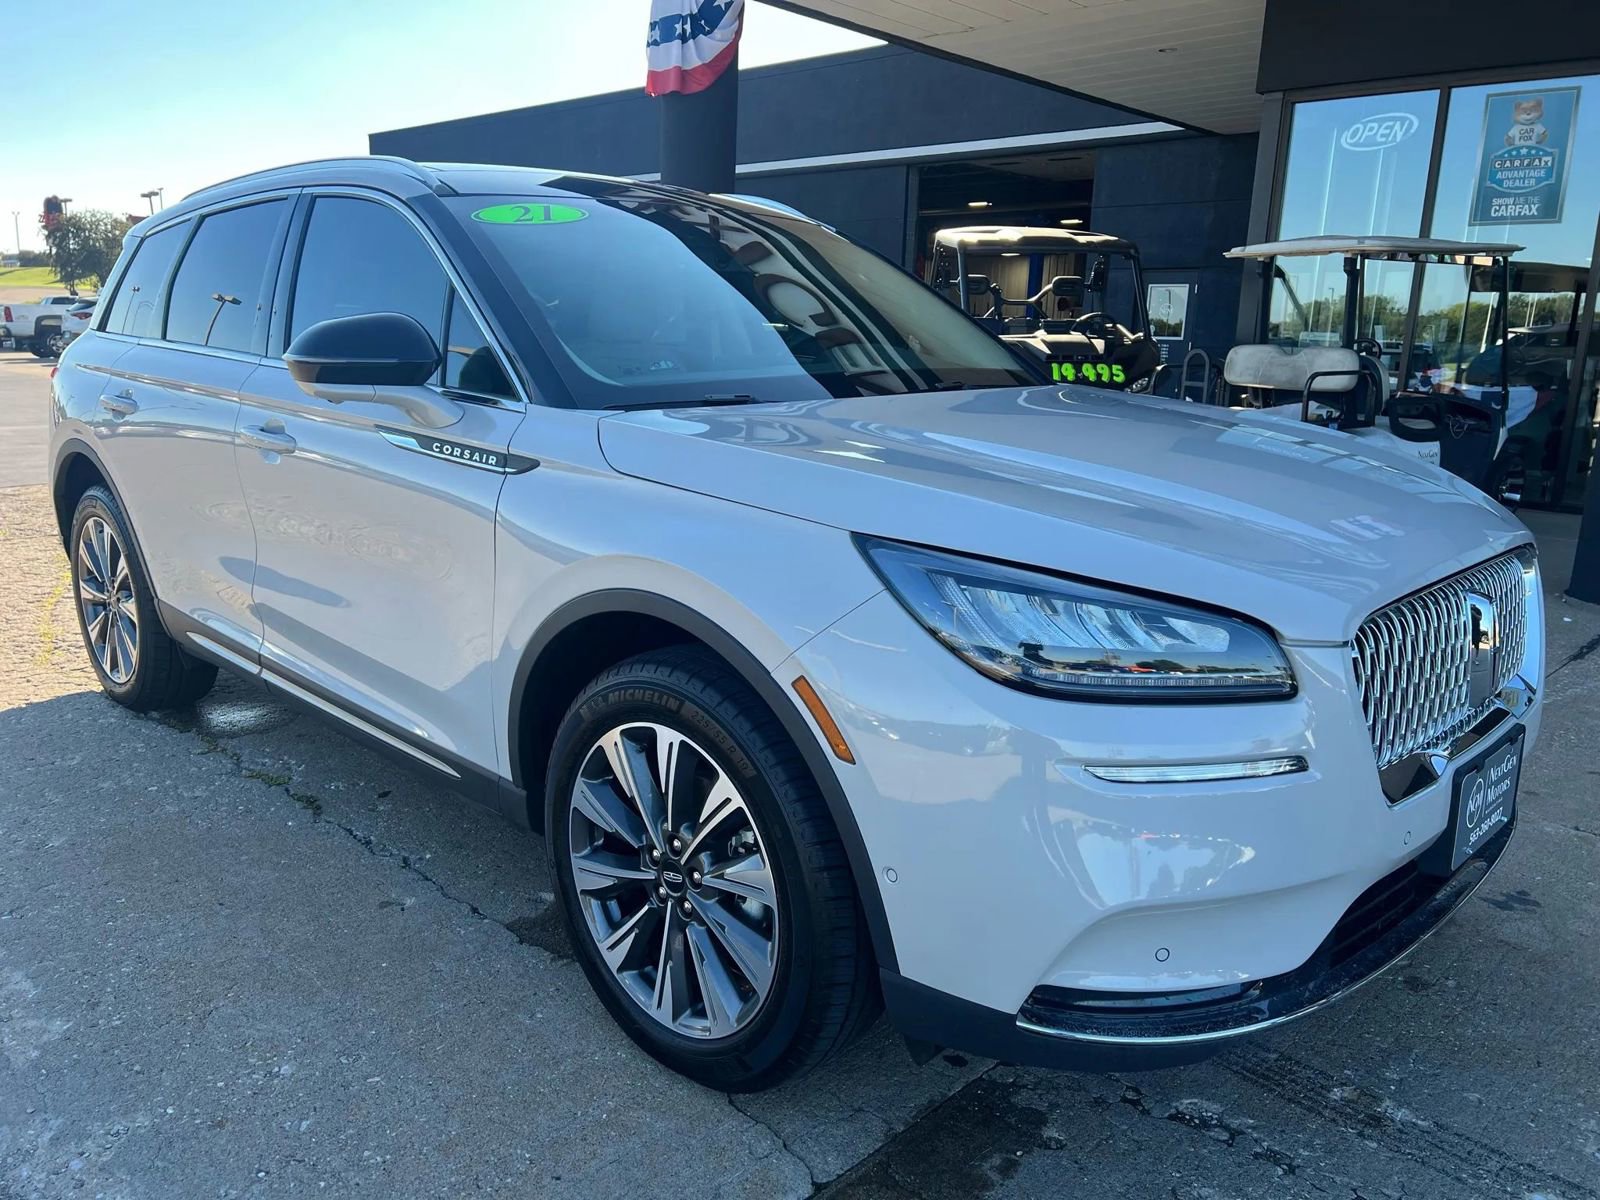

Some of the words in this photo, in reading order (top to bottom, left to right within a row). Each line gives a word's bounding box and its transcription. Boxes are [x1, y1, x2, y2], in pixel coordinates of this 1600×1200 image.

[1346, 120, 1410, 143] OPEN
[1518, 127, 1535, 136] CAR
[1494, 157, 1552, 168] CARFAX
[1496, 169, 1546, 179] ADVANTAGE
[1503, 178, 1536, 188] DEALER
[1491, 197, 1514, 205] SHOW
[510, 204, 553, 222] 21
[1490, 204, 1541, 217] CARFAX
[432, 442, 498, 466] CORSAIR
[608, 688, 681, 712] MICHELIN
